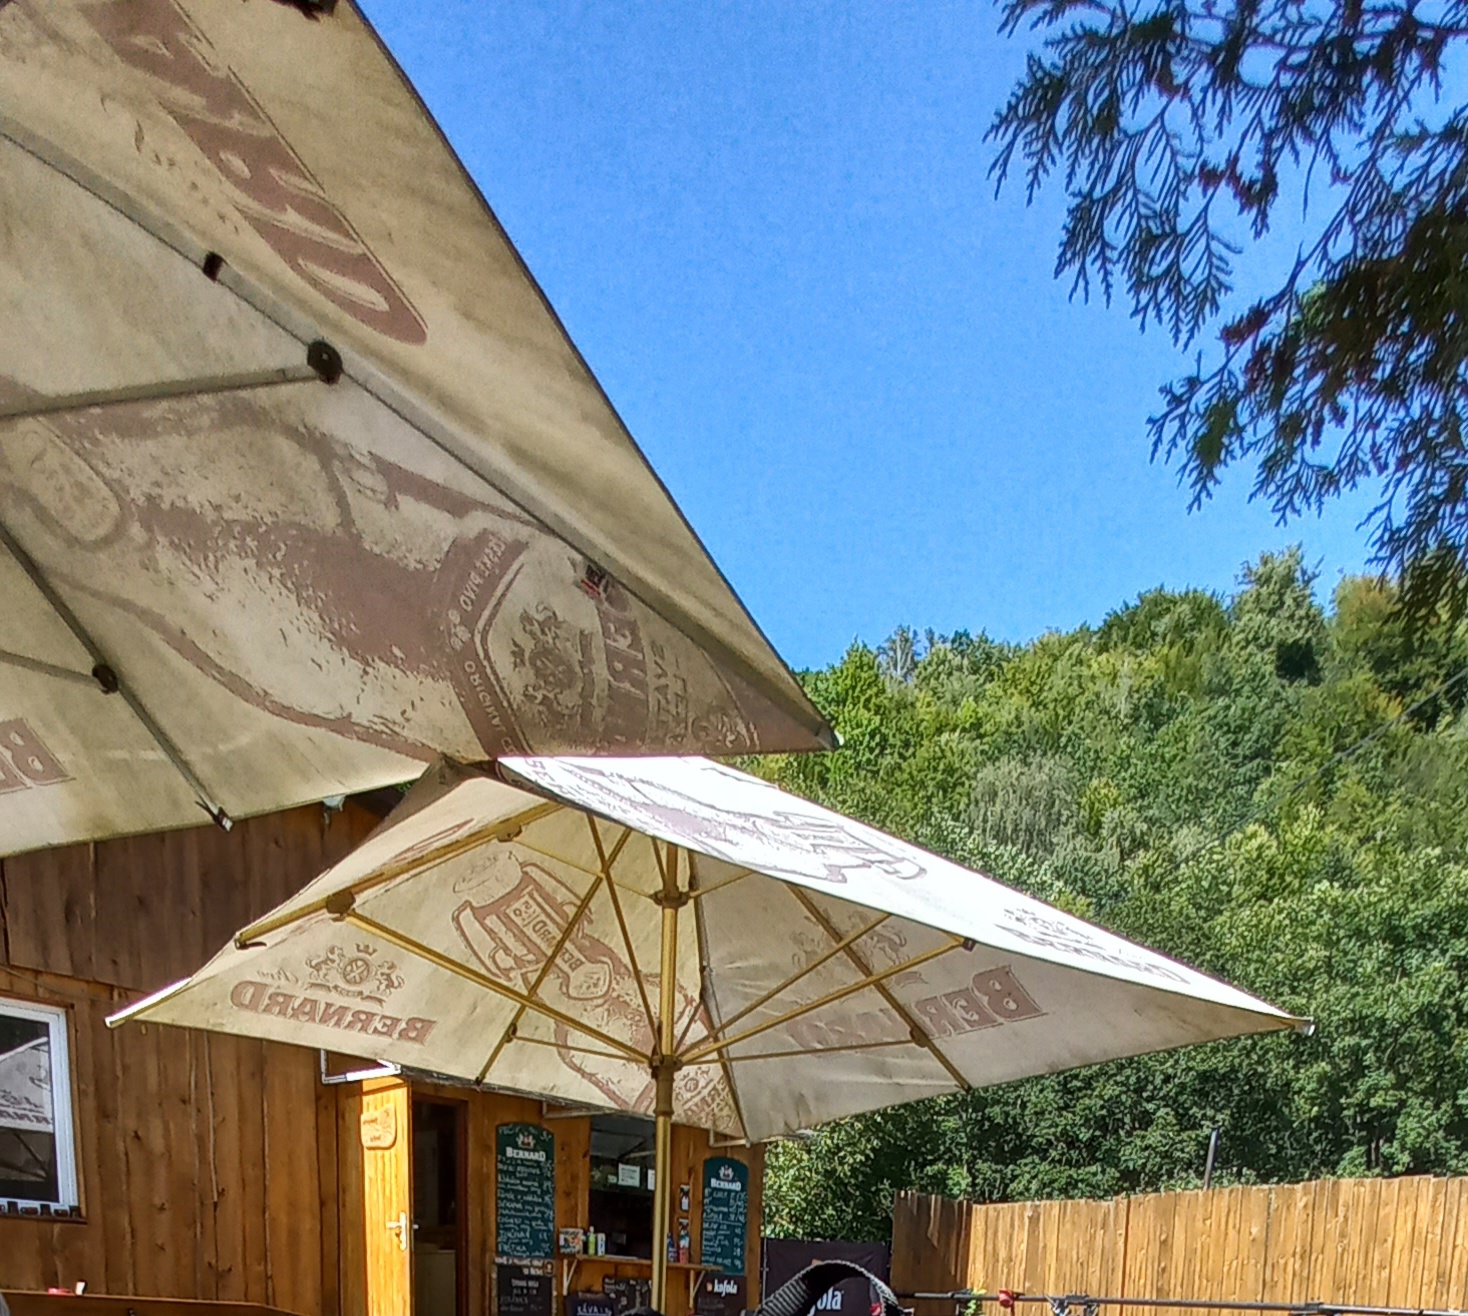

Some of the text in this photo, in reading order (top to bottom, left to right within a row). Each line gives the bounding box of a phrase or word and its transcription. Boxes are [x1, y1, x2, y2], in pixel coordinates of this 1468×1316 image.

[506, 1146, 546, 1161] BERNARD
[710, 1177, 741, 1191] BERNARD
[713, 1278, 738, 1298] kofola
